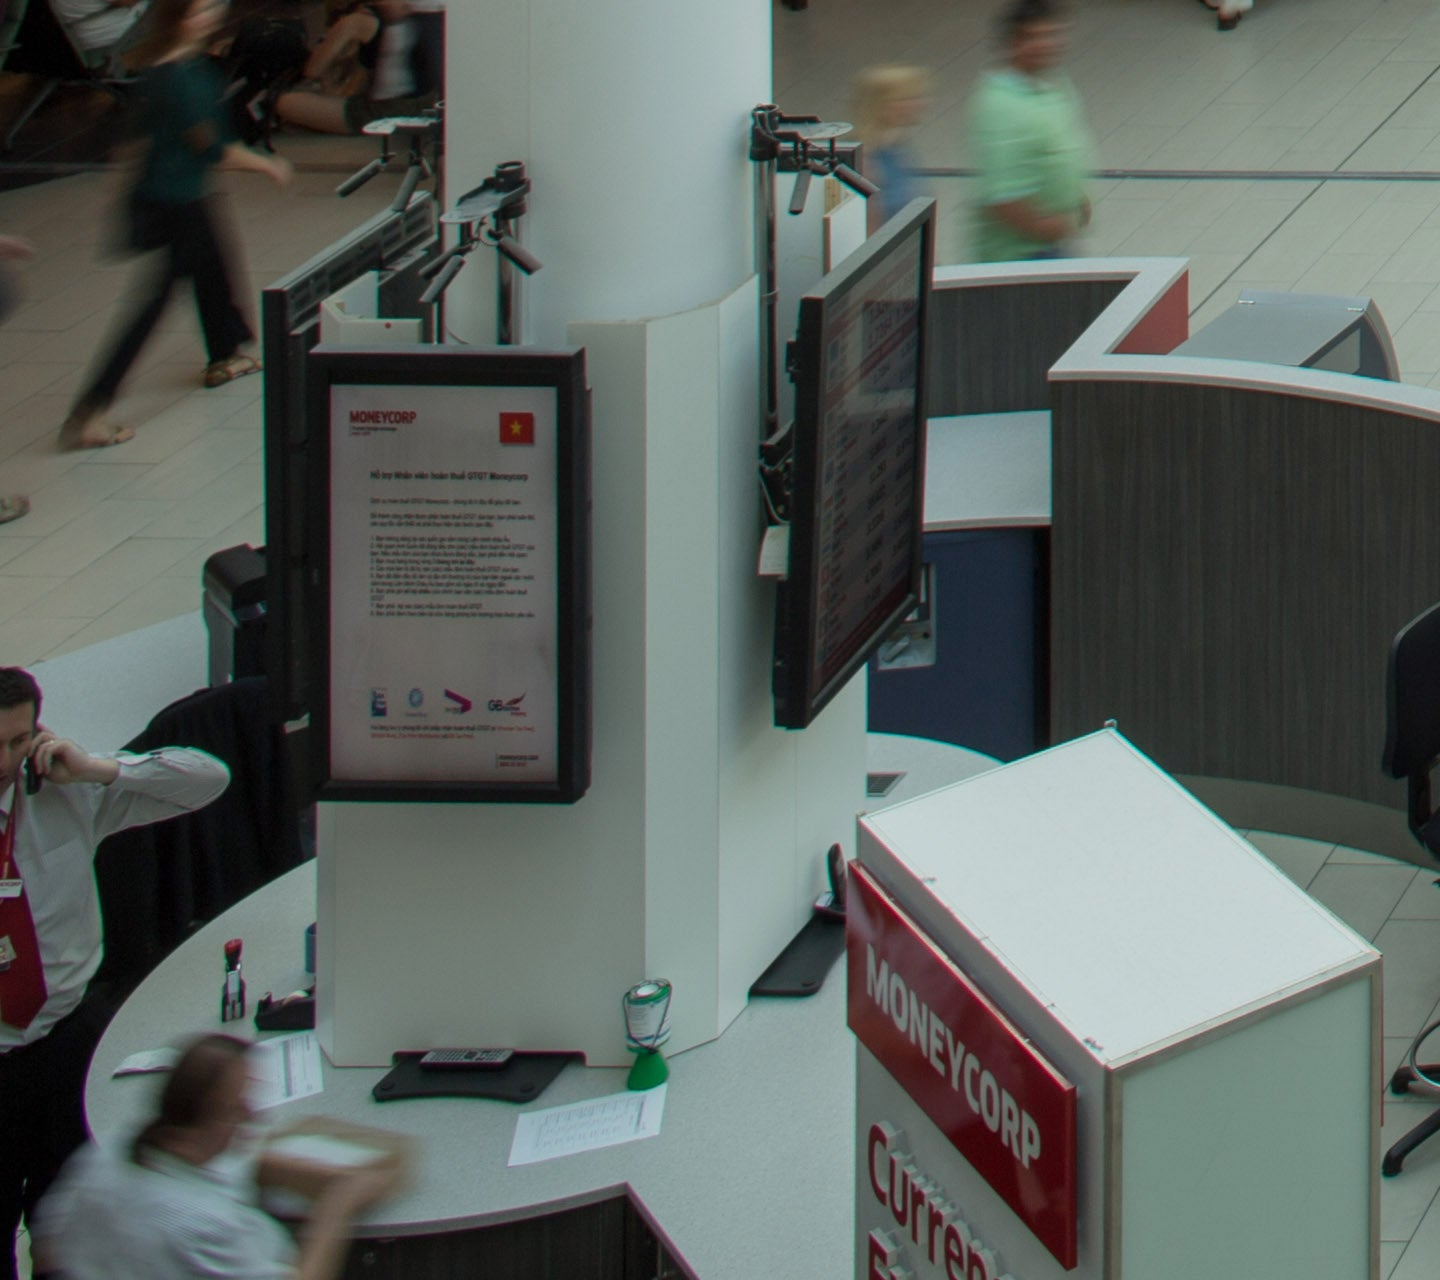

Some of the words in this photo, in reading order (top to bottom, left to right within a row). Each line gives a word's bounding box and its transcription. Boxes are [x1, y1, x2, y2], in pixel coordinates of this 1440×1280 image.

[349, 410, 417, 425] MONEYCORP
[489, 471, 528, 482] Moneycorp
[866, 943, 1041, 1170] MONEYCORP
